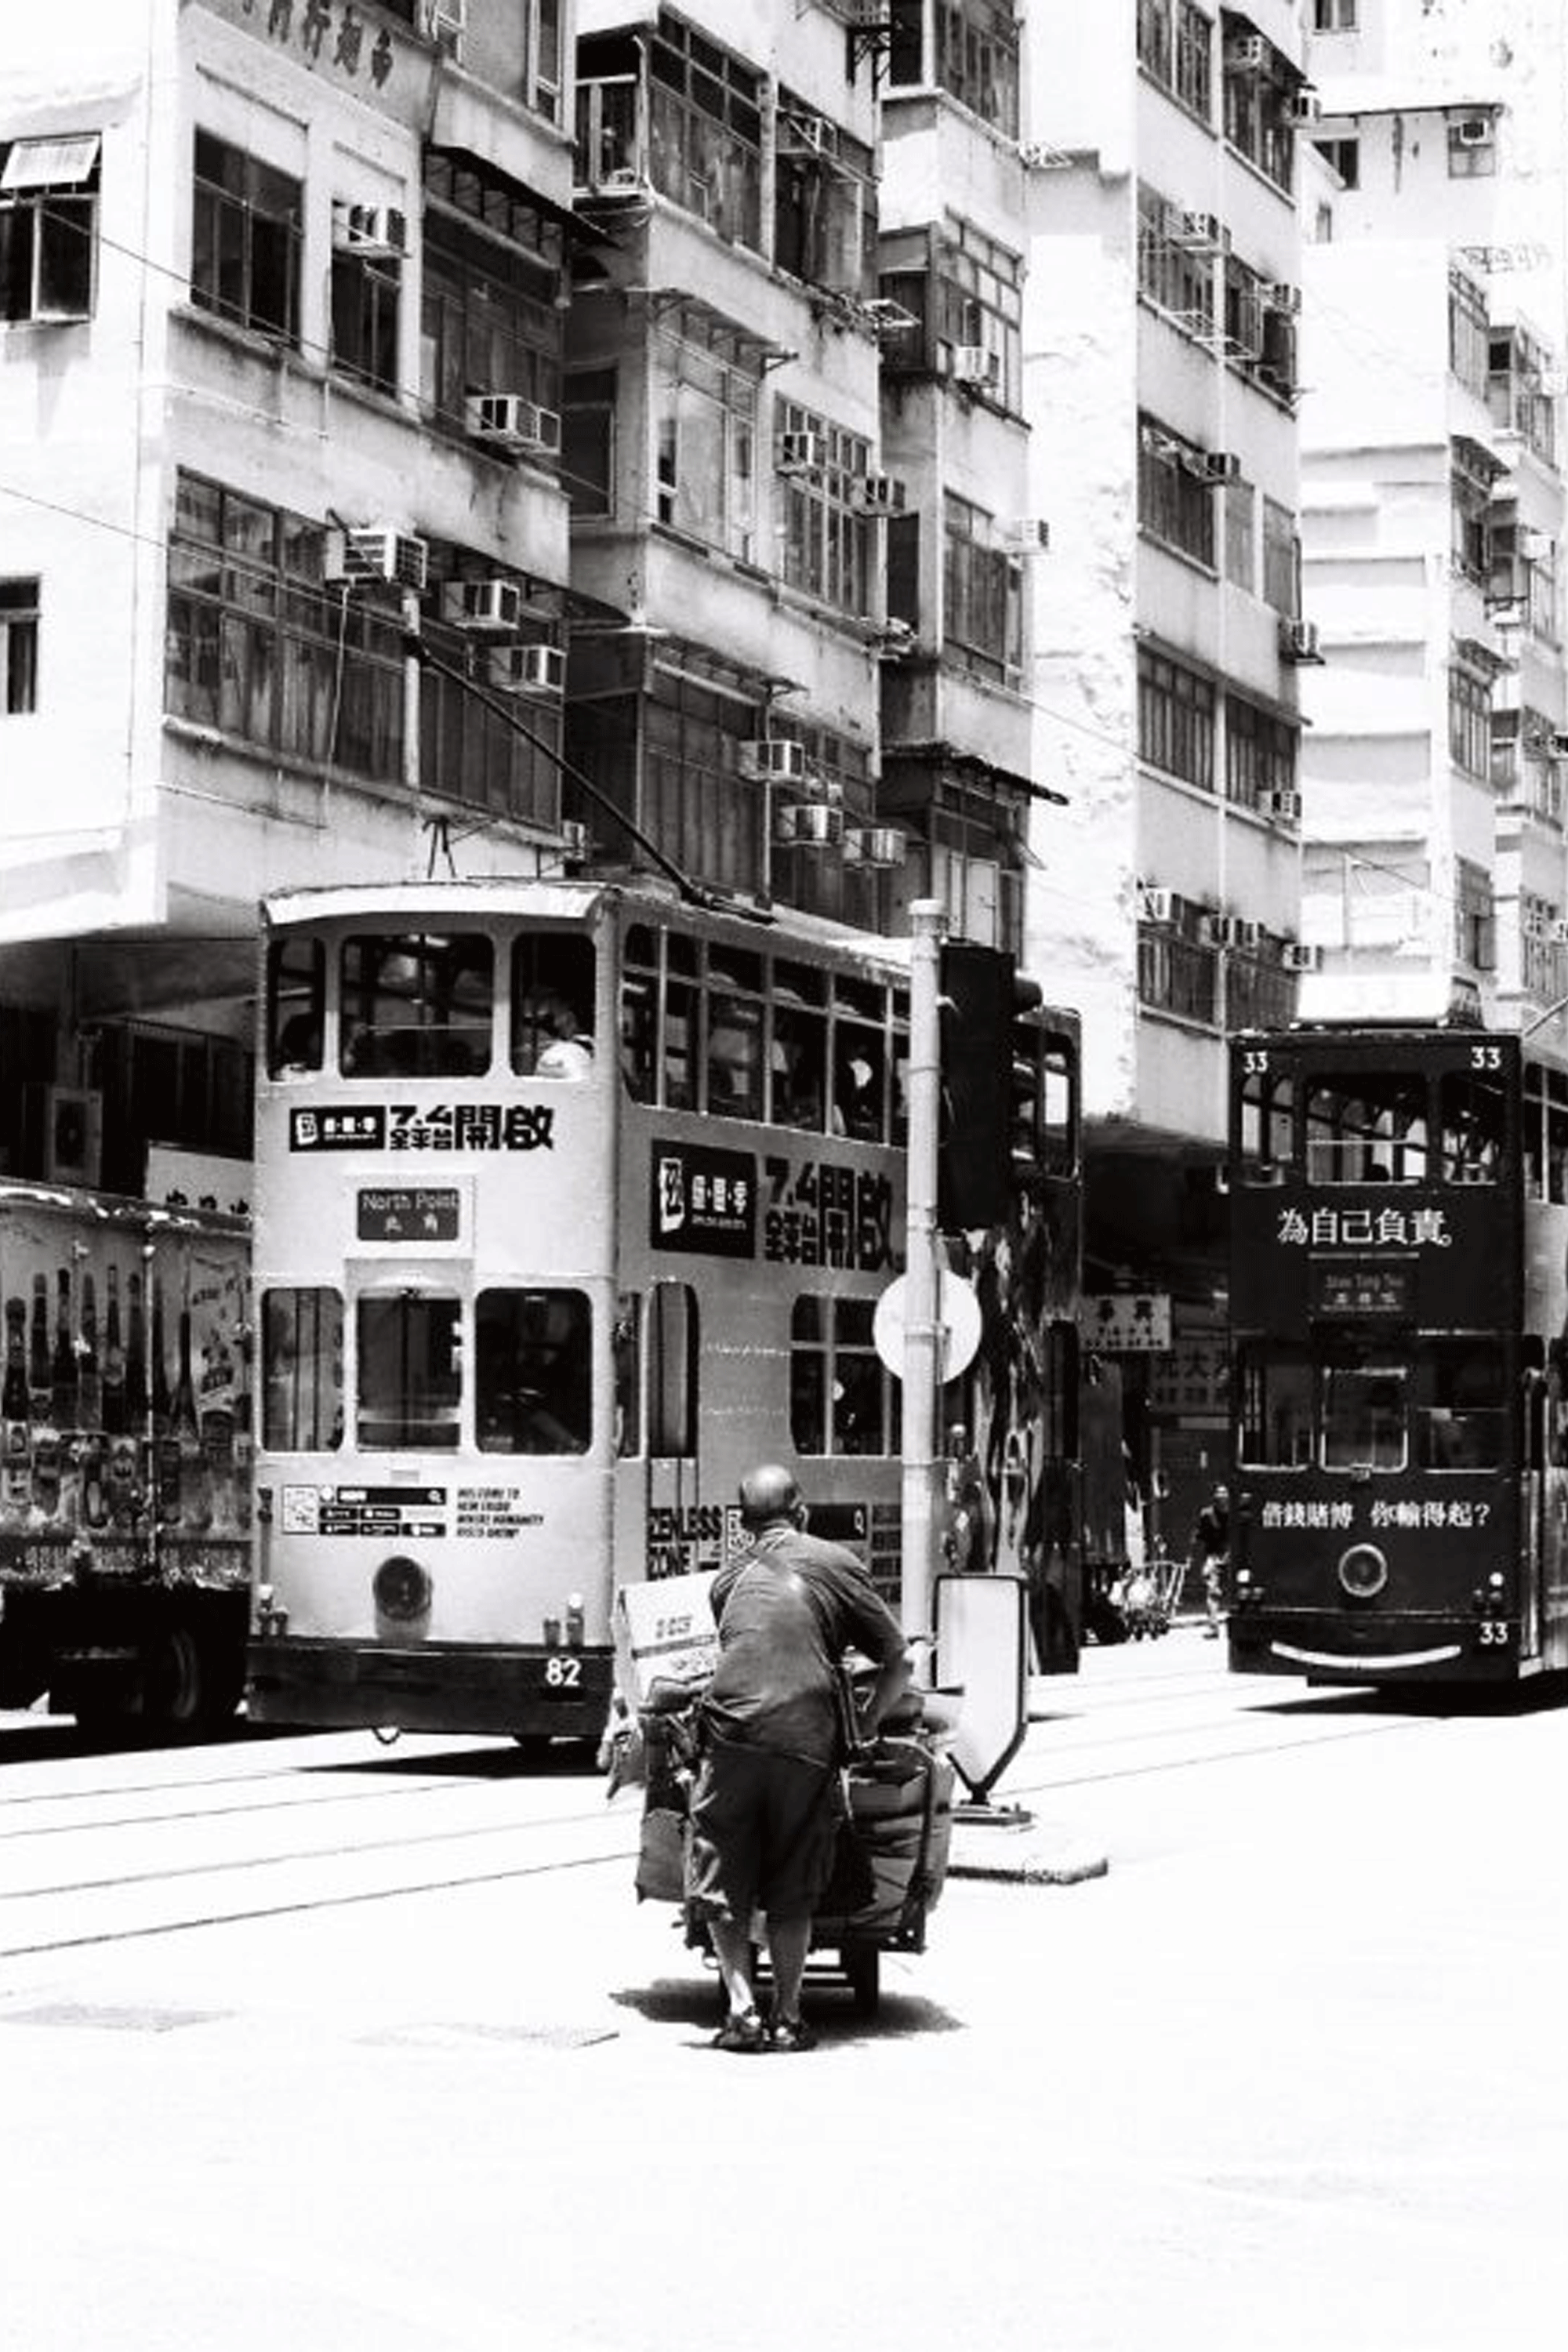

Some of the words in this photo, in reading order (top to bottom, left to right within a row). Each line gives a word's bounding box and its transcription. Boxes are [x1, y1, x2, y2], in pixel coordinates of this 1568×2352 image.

[1244, 1051, 1268, 1073] 33
[1471, 1047, 1501, 1069] 33
[455, 1105, 554, 1150] 開啟
[362, 1192, 412, 1210] North
[416, 1192, 459, 1210] Point
[649, 1506, 722, 1541] ZENLESS
[648, 1545, 691, 1581] ZONE
[1479, 1622, 1508, 1644] 33
[546, 1658, 582, 1686] 82
